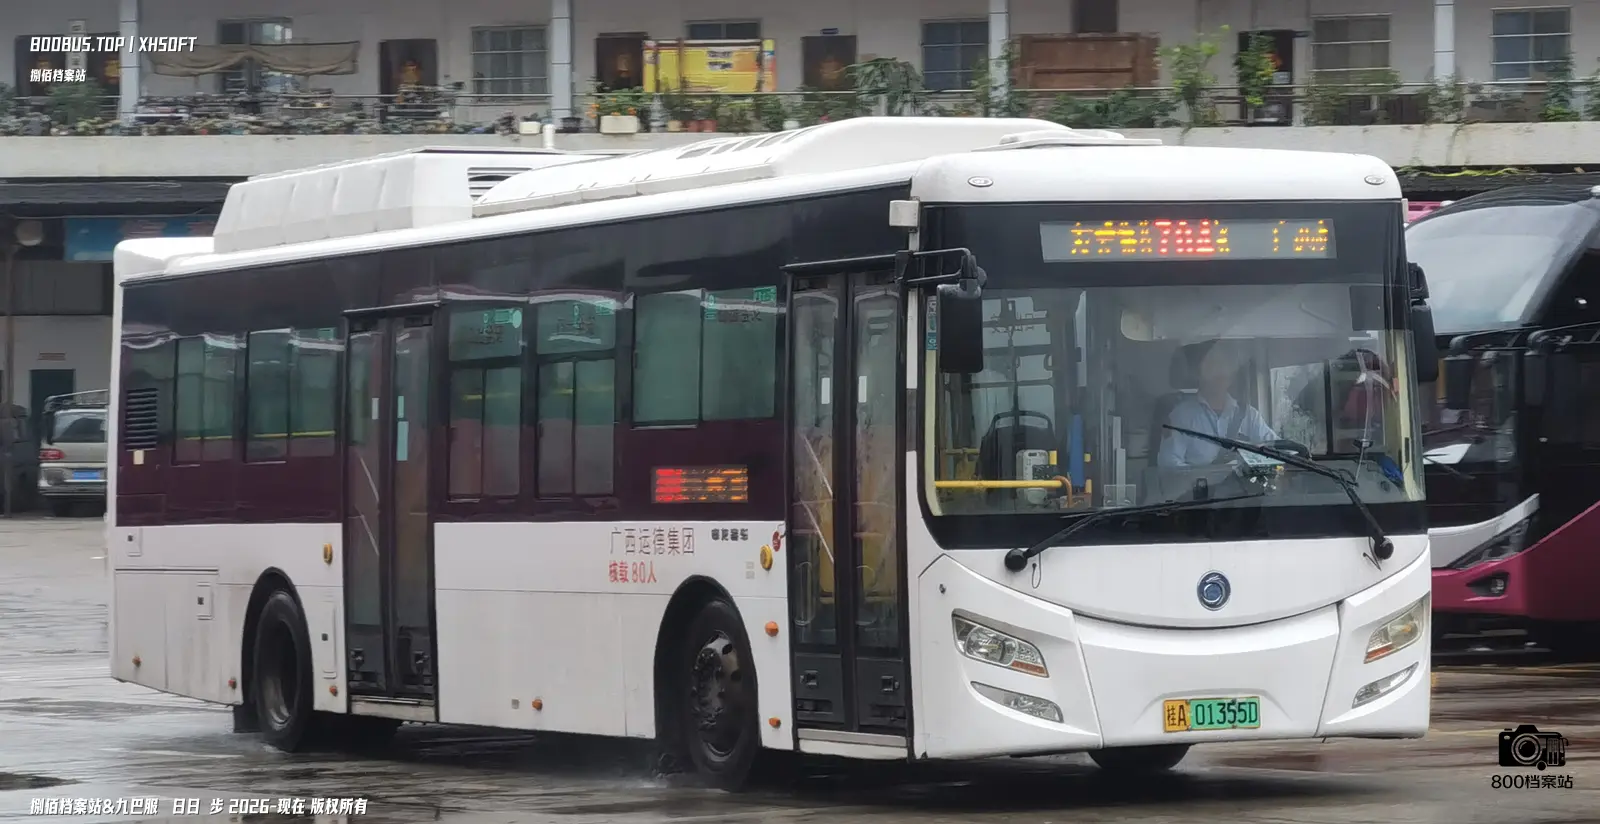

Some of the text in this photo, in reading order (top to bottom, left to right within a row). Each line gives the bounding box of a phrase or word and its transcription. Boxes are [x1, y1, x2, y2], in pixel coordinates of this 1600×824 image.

[610, 526, 695, 556] 广西运德集团
